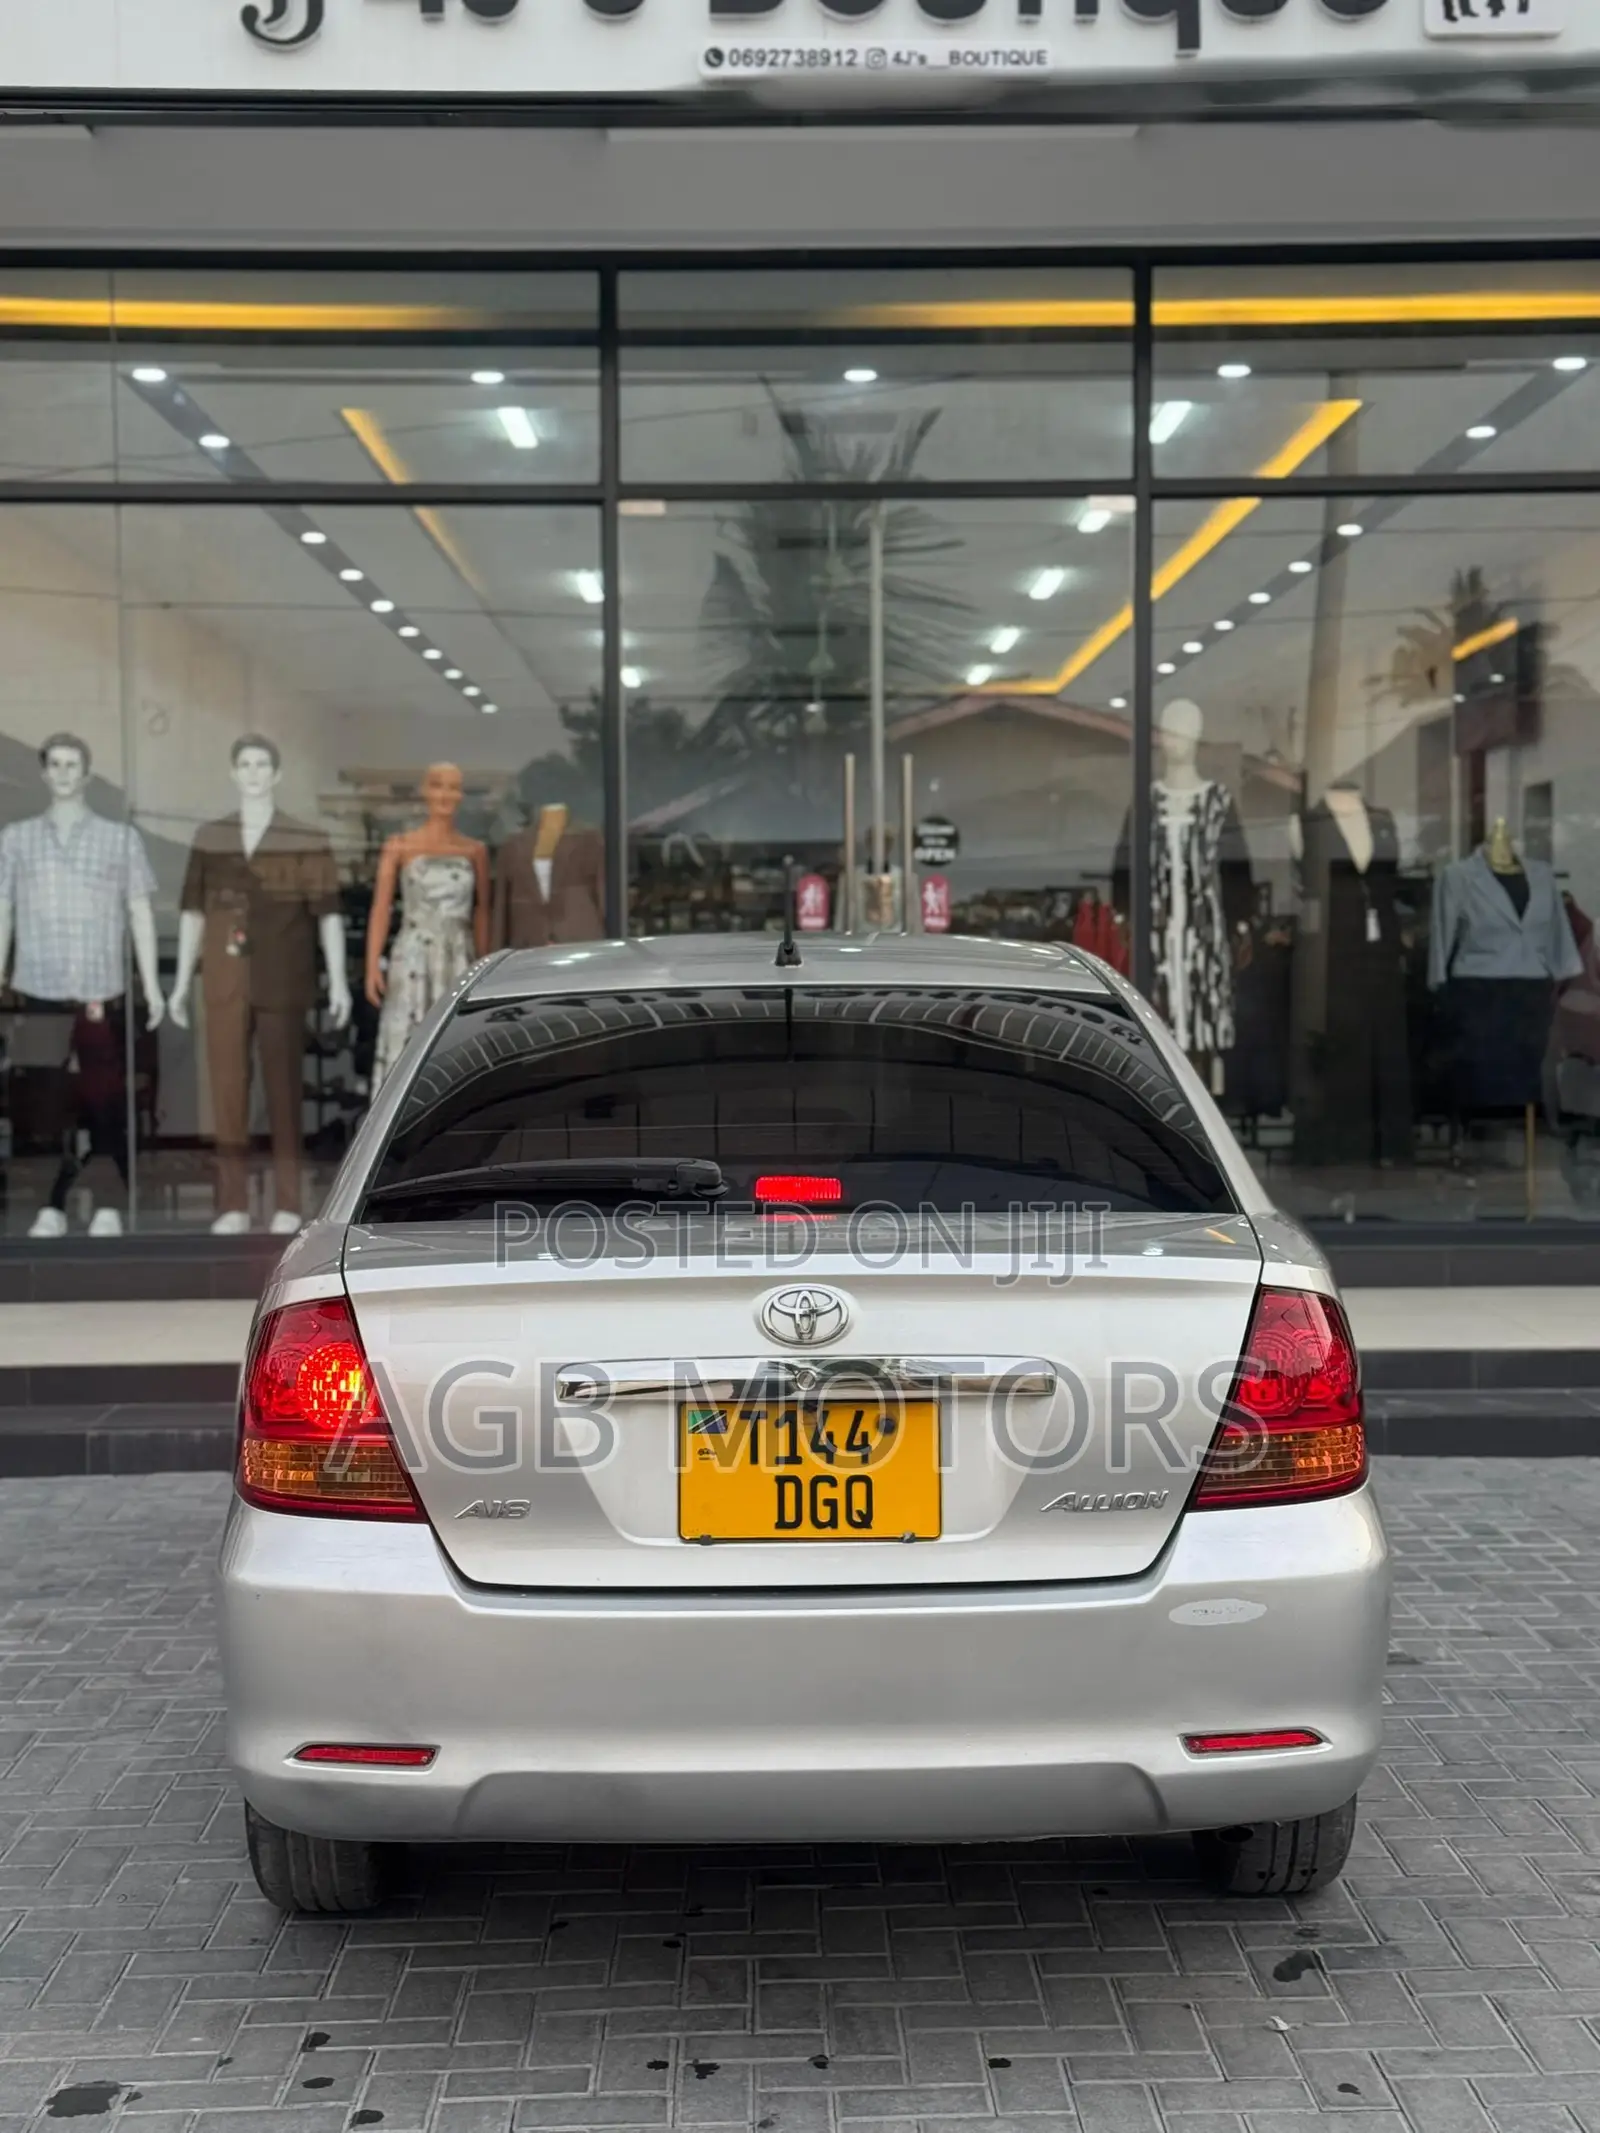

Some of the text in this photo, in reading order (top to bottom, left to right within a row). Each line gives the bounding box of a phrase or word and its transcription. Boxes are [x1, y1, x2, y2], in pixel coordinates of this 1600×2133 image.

[728, 48, 858, 67] 0692738912
[740, 1409, 873, 1465] T144
[774, 1474, 873, 1530] DGQ
[1040, 1490, 1169, 1513] ALLION
